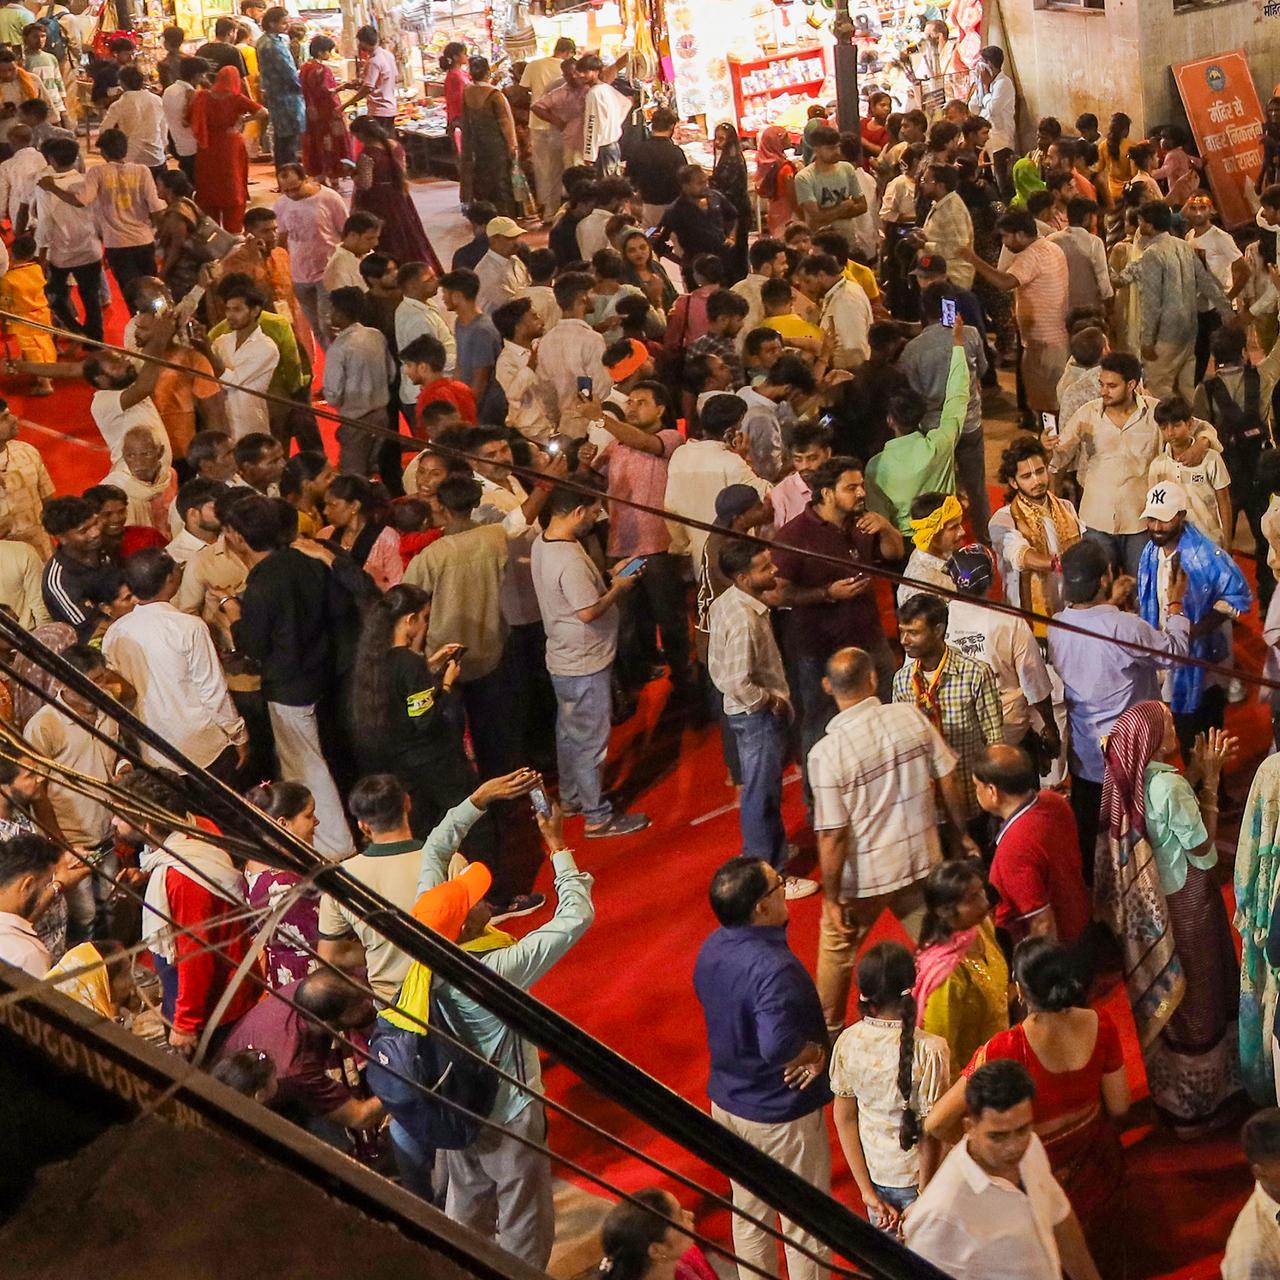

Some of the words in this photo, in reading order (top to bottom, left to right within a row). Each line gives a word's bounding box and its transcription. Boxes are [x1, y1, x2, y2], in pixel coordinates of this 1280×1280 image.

[1208, 100, 1234, 123] मंदिर
[1232, 95, 1245, 118] से
[1203, 131, 1227, 152] बाहर
[1151, 489, 1167, 504] NY
